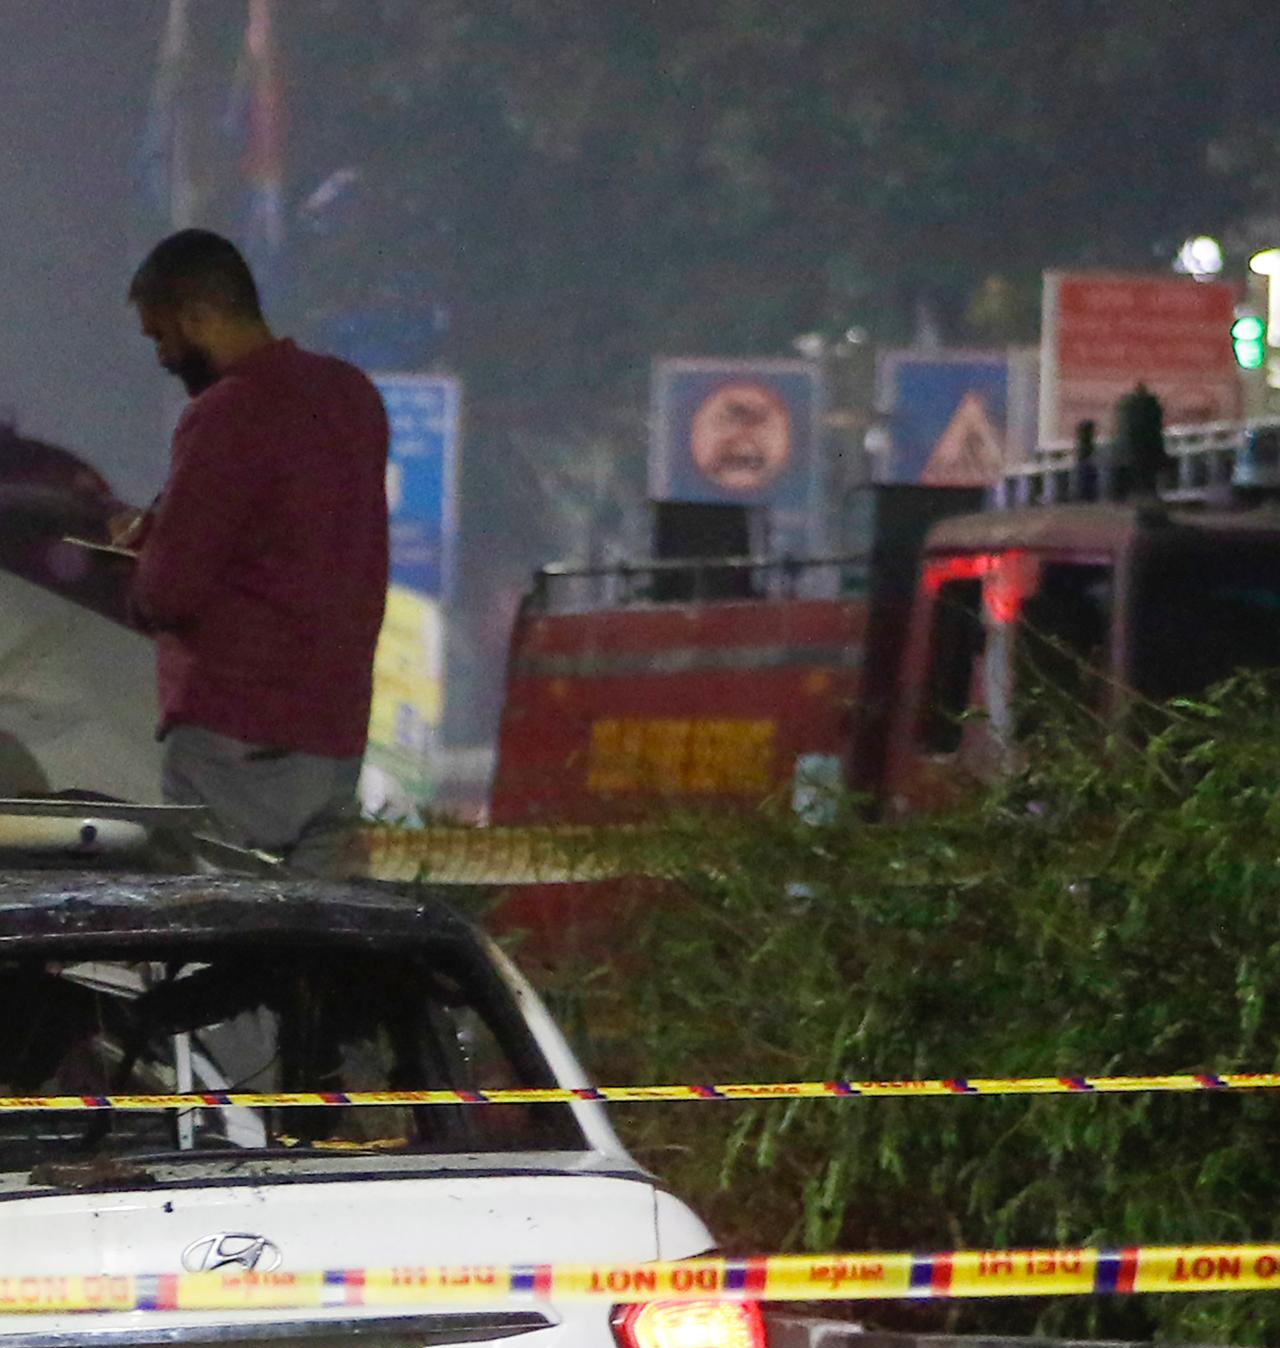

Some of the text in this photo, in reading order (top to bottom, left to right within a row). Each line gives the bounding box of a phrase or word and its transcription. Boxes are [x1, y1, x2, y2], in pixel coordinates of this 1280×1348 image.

[587, 1268, 719, 1294] DO NOT
[1168, 1256, 1241, 1283] NOT
